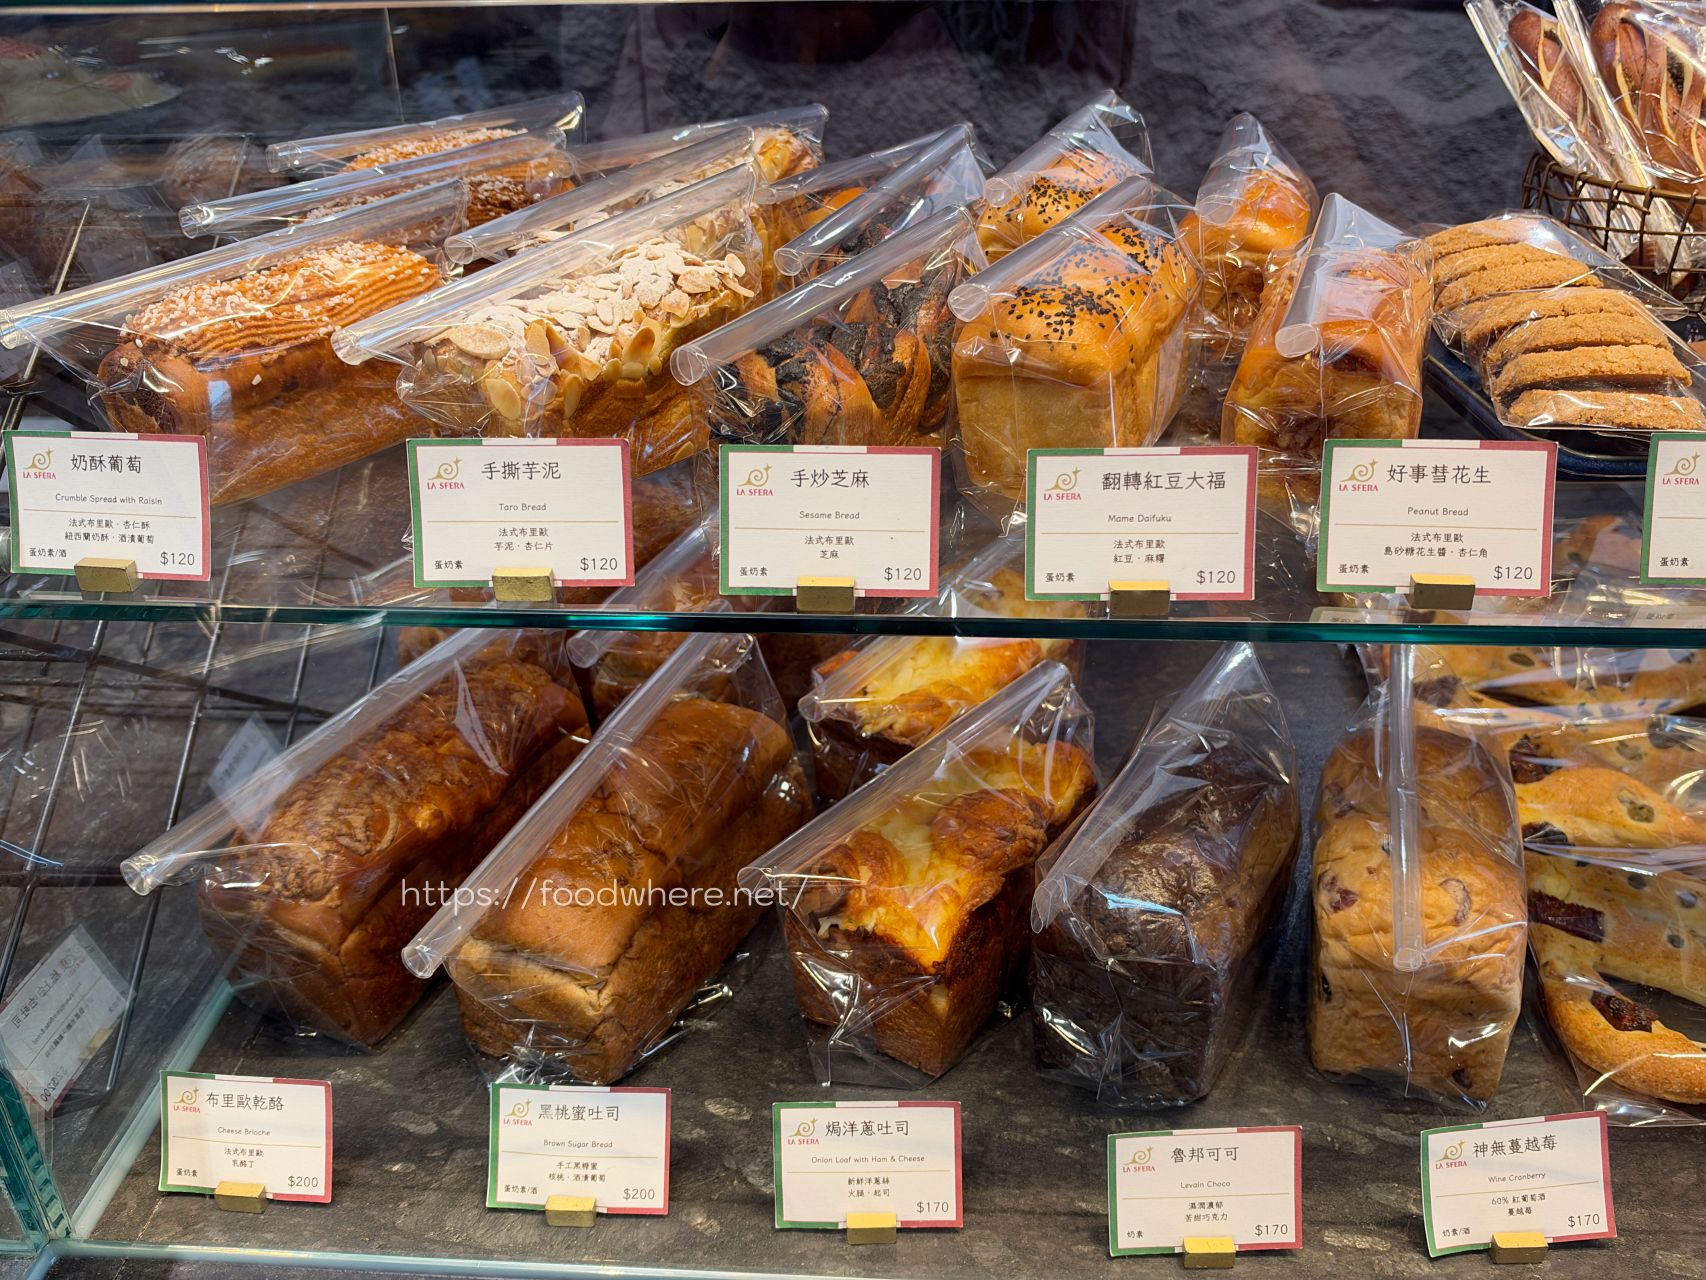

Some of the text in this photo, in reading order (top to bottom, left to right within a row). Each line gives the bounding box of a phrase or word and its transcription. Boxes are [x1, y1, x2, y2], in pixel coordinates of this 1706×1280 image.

[70, 454, 142, 473] 奶酥葡萄
[23, 471, 31, 479] LA
[481, 461, 561, 480] 手撕芋泥
[1386, 464, 1491, 484] 好事彗花生
[790, 469, 870, 488] 手炒芝麻
[1102, 471, 1226, 491] 翻轉紅豆大福
[1662, 477, 1700, 485] LA SFERA
[1352, 484, 1378, 492] SFERA
[55, 493, 162, 505] Crumble Spread with Raisin
[499, 503, 547, 511] Taro Bread
[1407, 507, 1469, 516] Peanut Bread
[799, 511, 860, 519] Sesame Bread
[1108, 514, 1171, 523] Mame Daifuku
[499, 528, 549, 537] 法式布里歐
[805, 536, 854, 546] 法式布里歐
[1411, 533, 1463, 543] 法式布里歐
[1113, 540, 1166, 549] 法式布里歐
[29, 548, 67, 558] 蛋奶素/酒
[819, 550, 839, 560] 芝麻
[160, 552, 195, 565] $120
[1660, 557, 1689, 567] 蛋奶素
[434, 560, 464, 570] 蛋奶素
[580, 557, 618, 571] $120
[1338, 563, 1370, 574] 蛋奶素
[739, 567, 768, 577] 蛋奶素
[884, 567, 921, 582] $120
[1493, 565, 1533, 580] $120
[1045, 572, 1075, 583] 蛋奶素
[1196, 570, 1236, 585] $120
[206, 1092, 284, 1110] 布里歐乾酪
[538, 1104, 619, 1122] 黑桃蜜吐司
[244, 1128, 270, 1136] Brioche
[544, 1139, 566, 1147] Brown
[568, 1140, 589, 1149] Sugar
[1473, 1134, 1557, 1157] 神無蔓越莓
[224, 1148, 264, 1157] 法式布里歐
[1171, 1146, 1240, 1163] 魯邦可可
[176, 1168, 198, 1177] 蛋奶素
[1488, 1172, 1545, 1183] Wine Cranberry
[288, 1176, 318, 1188] $200
[1207, 1180, 1230, 1188] Choco
[504, 1185, 538, 1194] 蛋奶素/酒
[623, 1188, 655, 1200] $200
[1491, 1193, 1546, 1206] 60% 紅葡萄酒
[916, 1201, 949, 1213] $170
[1568, 1213, 1600, 1228] $170
[1127, 1230, 1143, 1239] 奶素
[1255, 1224, 1288, 1236] $170
[1442, 1227, 1471, 1237] 奶素/酒
